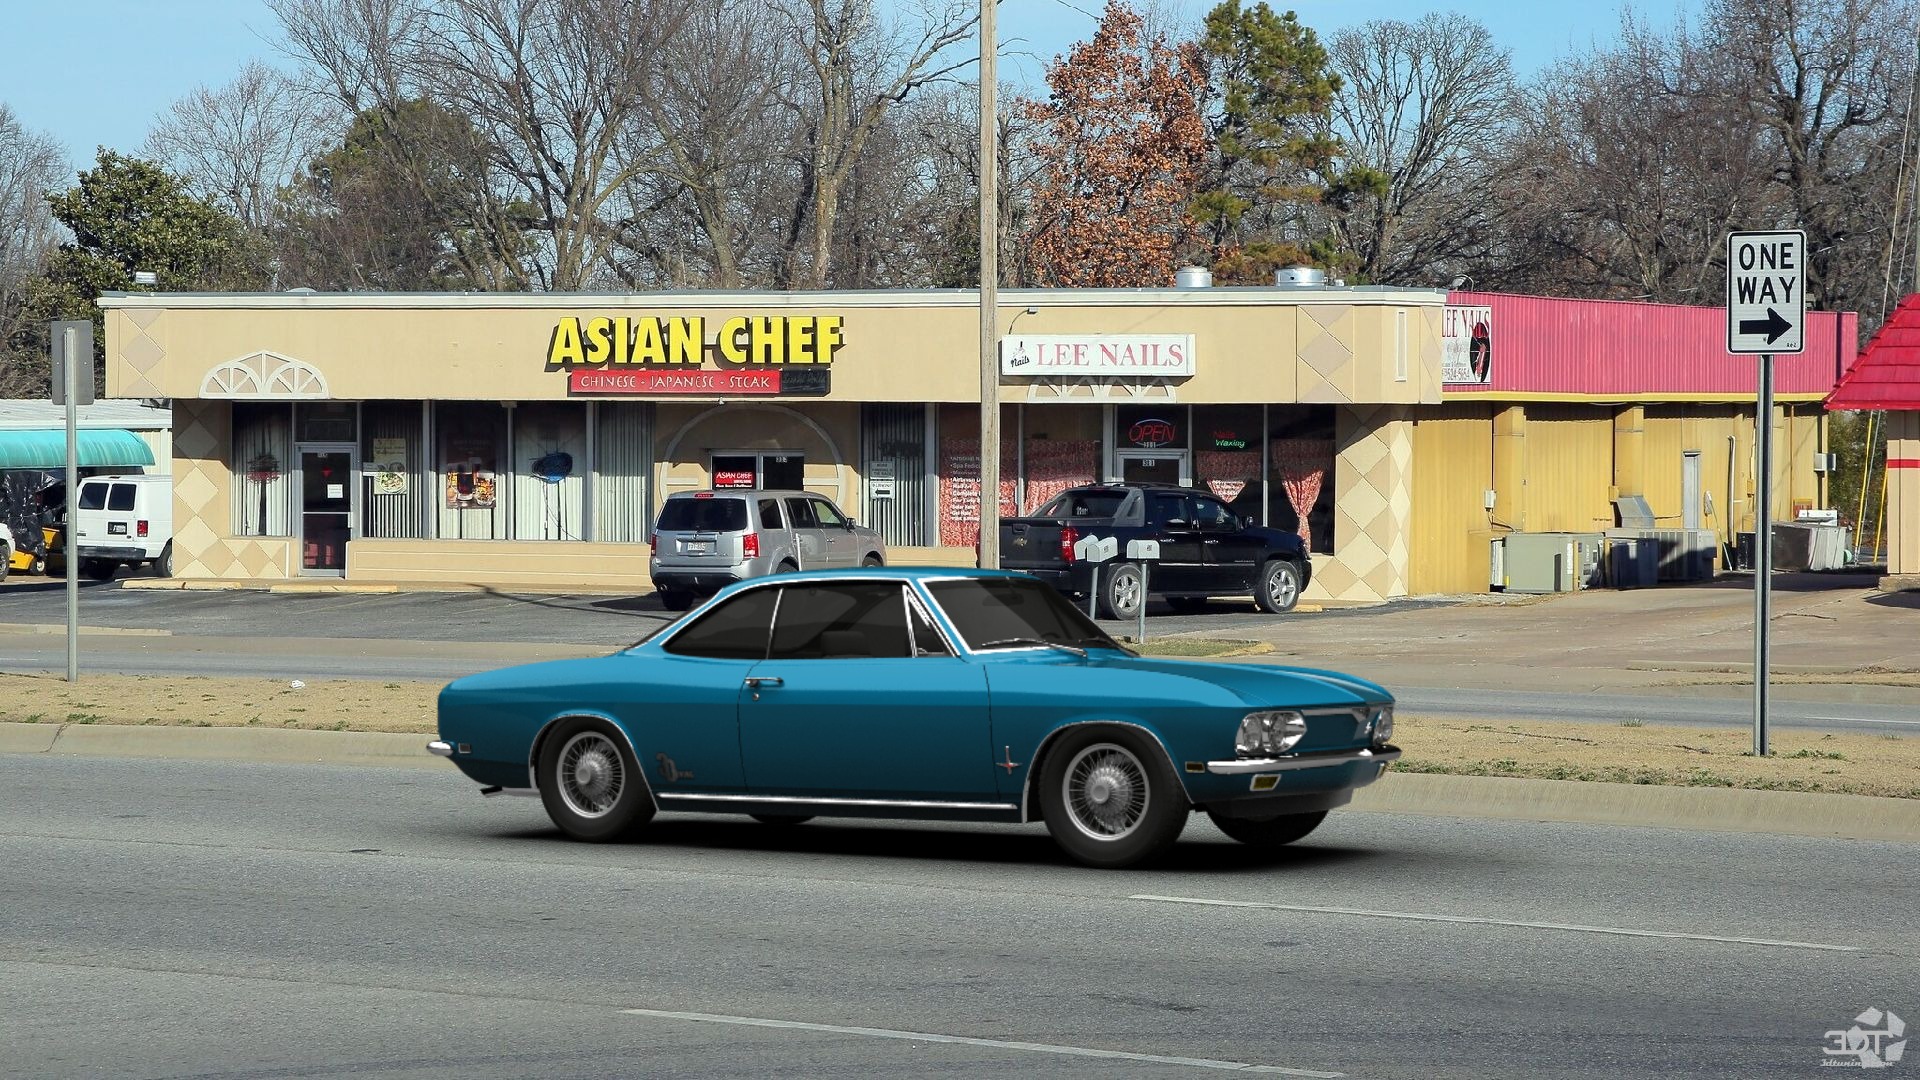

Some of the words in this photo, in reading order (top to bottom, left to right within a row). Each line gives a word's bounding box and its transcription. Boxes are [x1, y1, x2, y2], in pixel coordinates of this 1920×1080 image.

[1739, 243, 1794, 270] ONE
[1737, 276, 1796, 304] WAY
[549, 316, 703, 364] ASIAN
[719, 315, 843, 364] CHEF
[1010, 355, 1031, 368] Nails
[1036, 343, 1090, 366] LEE
[1099, 343, 1184, 366] NAILS
[580, 375, 637, 388] CHINESE
[649, 375, 715, 389] JAPANESE
[729, 375, 770, 388] STEAK
[1128, 425, 1177, 442] OPEN
[1215, 439, 1246, 449] Waxing
